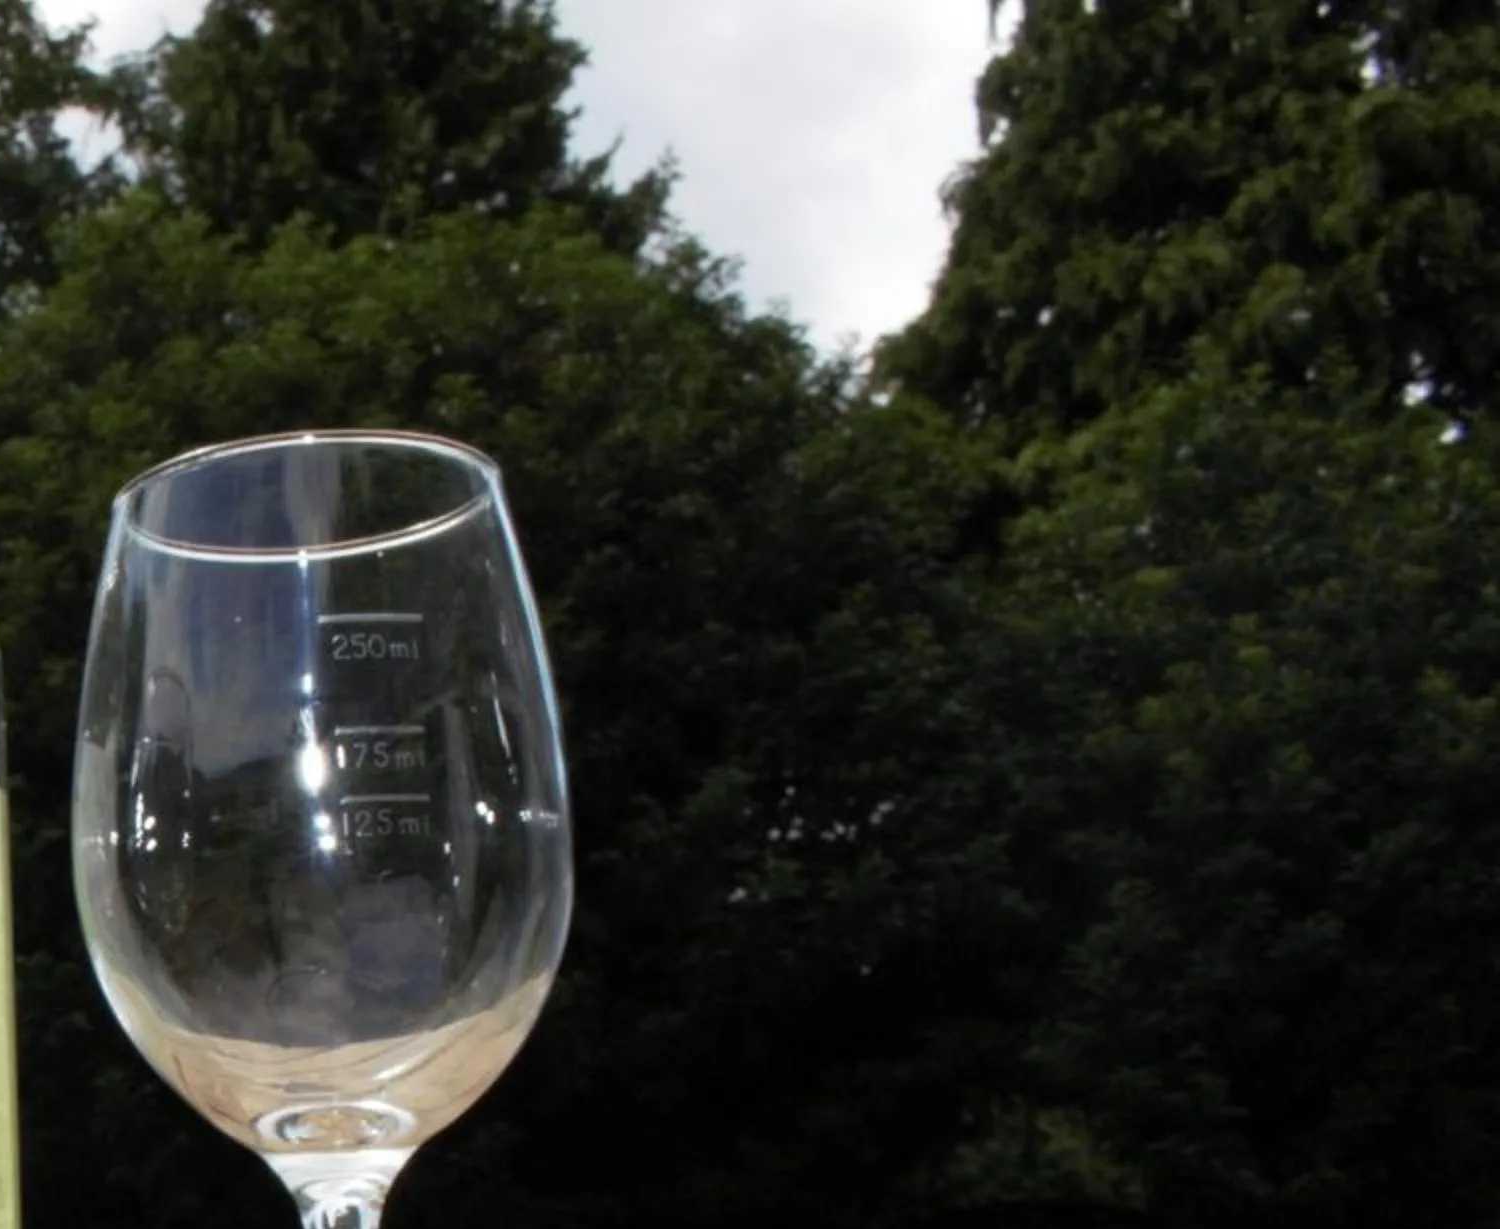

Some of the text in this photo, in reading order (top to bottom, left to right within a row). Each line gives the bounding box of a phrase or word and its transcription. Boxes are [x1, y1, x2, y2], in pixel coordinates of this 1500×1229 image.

[331, 633, 420, 660] 250ml
[336, 742, 426, 769] 175ml
[342, 808, 431, 838] 125ml
